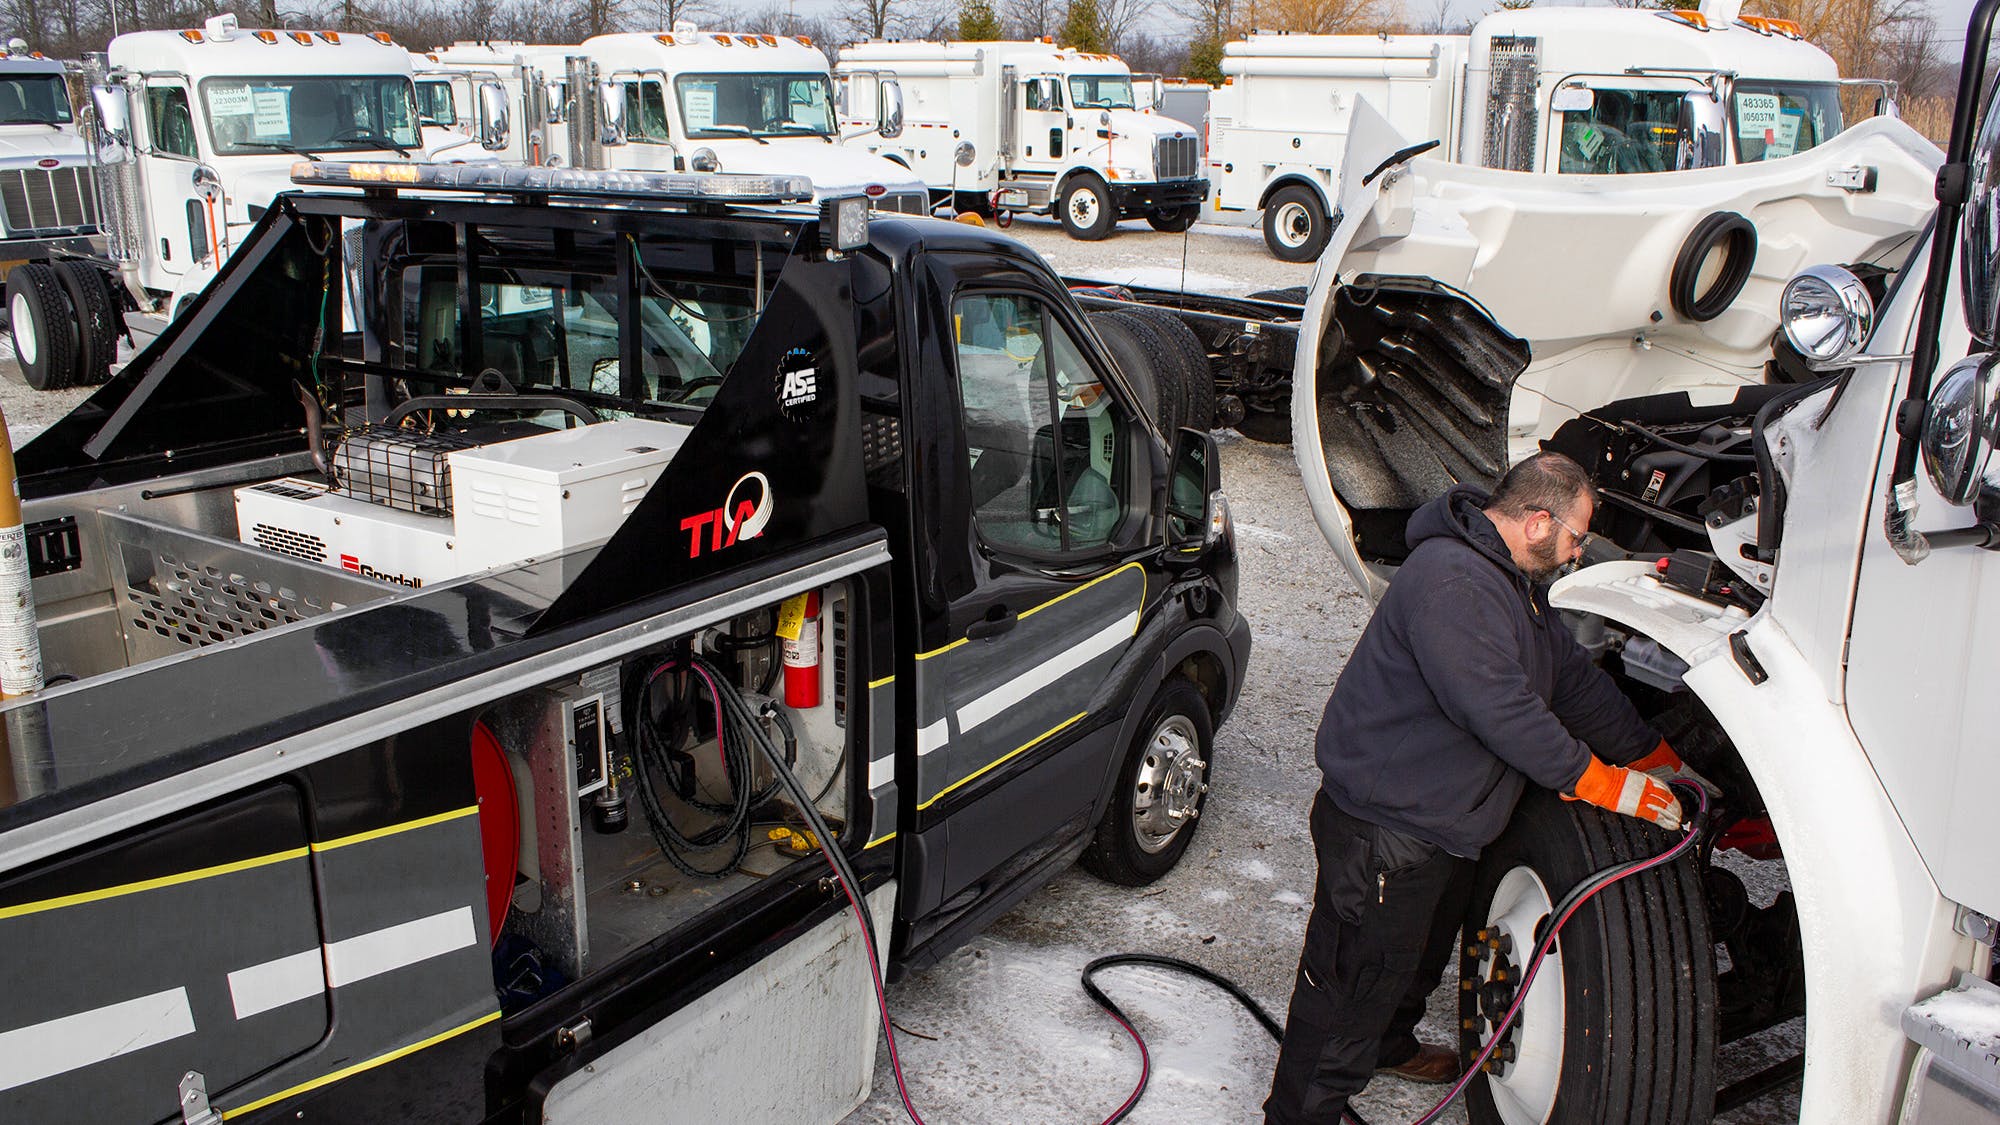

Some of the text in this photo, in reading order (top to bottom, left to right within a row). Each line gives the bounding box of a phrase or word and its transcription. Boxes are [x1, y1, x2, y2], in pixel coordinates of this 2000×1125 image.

[1743, 98, 1774, 109] 483365
[782, 368, 817, 400] ASE
[785, 393, 817, 407] CERTIFIED
[681, 500, 764, 559] TIA
[782, 619, 797, 629] 2017
